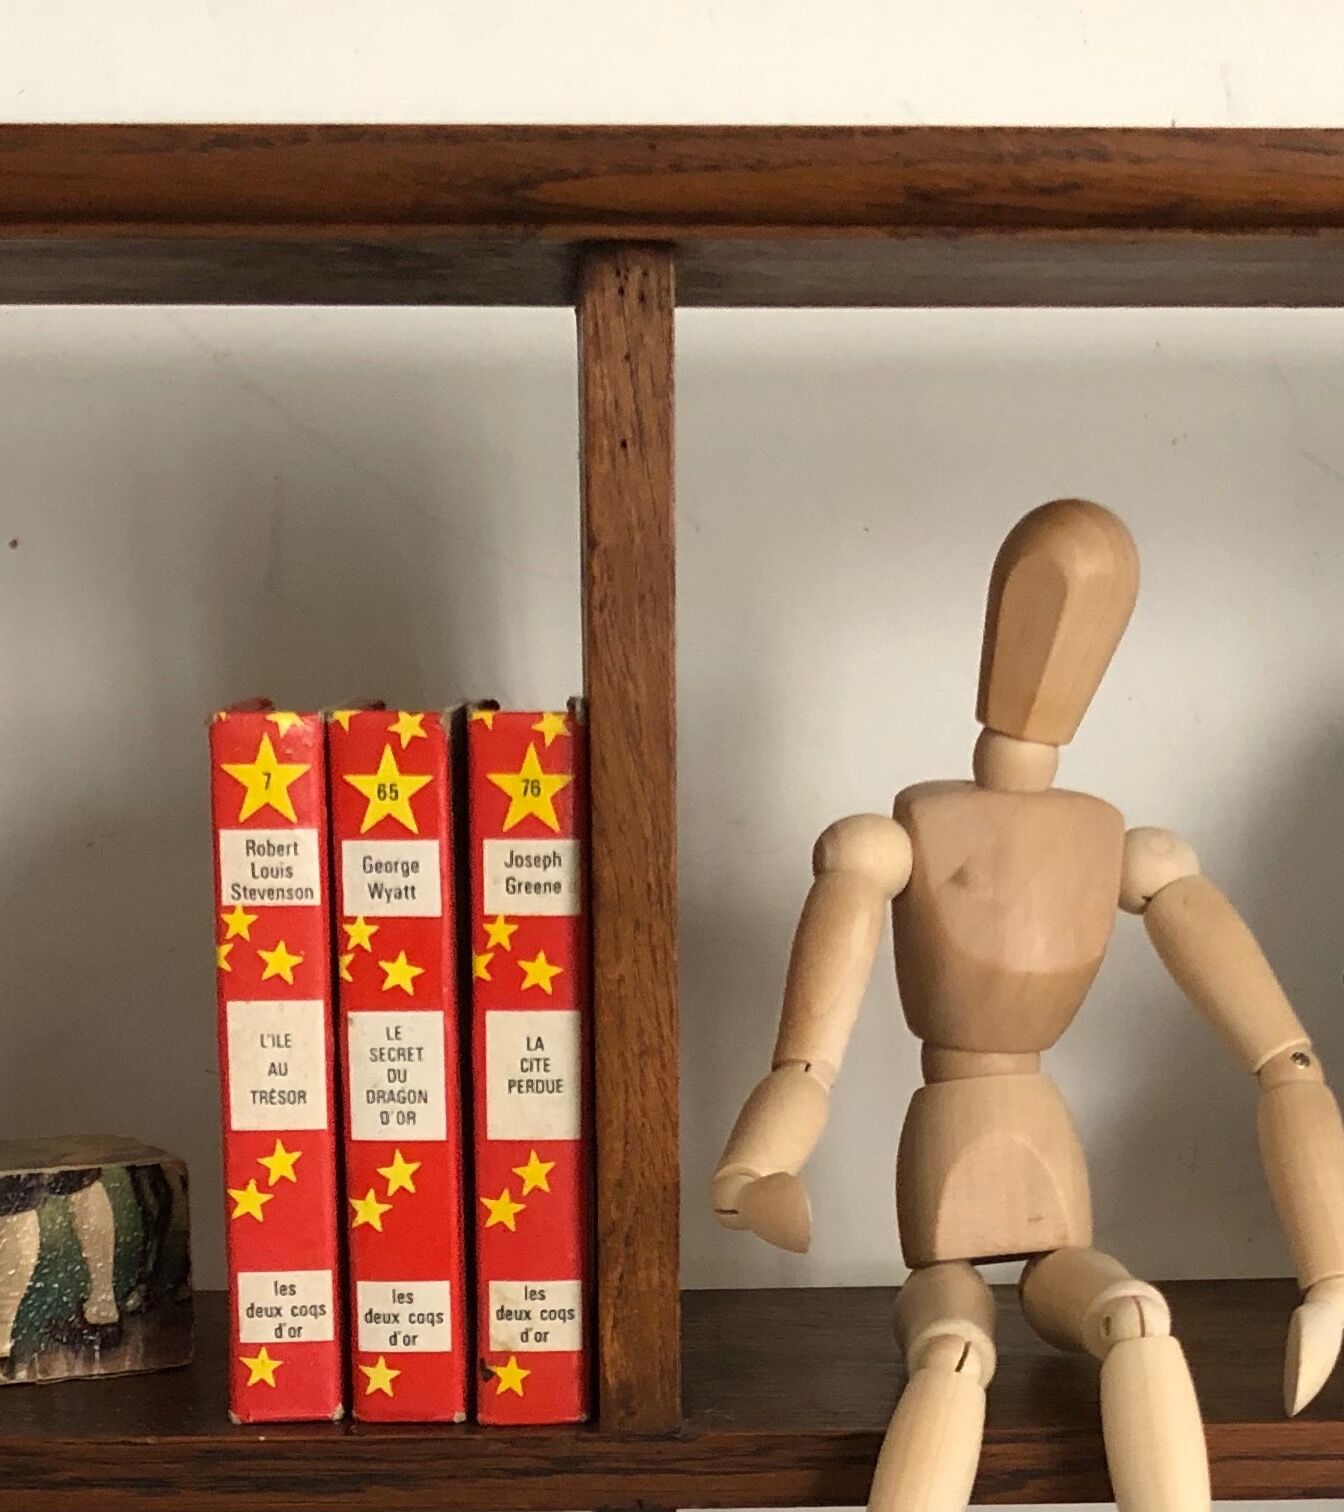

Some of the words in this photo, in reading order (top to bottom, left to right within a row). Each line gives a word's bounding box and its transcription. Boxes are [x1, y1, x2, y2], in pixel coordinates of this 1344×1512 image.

[261, 771, 273, 791] 7
[520, 778, 542, 798] 76
[376, 782, 400, 802] 65
[244, 838, 299, 858] Robert
[250, 861, 294, 880] Louis
[361, 854, 421, 878] George
[503, 849, 563, 873] Joseph
[229, 882, 315, 901] Stevenson
[367, 881, 417, 904] Wyatt
[504, 875, 563, 896] Greene
[259, 1032, 293, 1049] L'ILE
[385, 1025, 403, 1041] LE
[525, 1035, 545, 1052] LA
[368, 1046, 425, 1063] SECRET
[267, 1061, 289, 1077] AU
[519, 1056, 552, 1073] CITE
[386, 1067, 408, 1084] DU
[507, 1078, 565, 1095] PERDUE
[365, 1088, 429, 1105] DRAGON
[272, 1279, 297, 1297] les
[391, 1288, 415, 1305] les
[523, 1284, 547, 1302] les
[245, 1302, 283, 1320] deux
[289, 1304, 327, 1321] coqs
[364, 1308, 401, 1326] deux
[407, 1311, 445, 1328] coqs
[495, 1305, 532, 1322] deux
[539, 1307, 576, 1324] coqs
[273, 1321, 304, 1340] d'or
[388, 1330, 419, 1348] d'or
[519, 1326, 550, 1345] d'or
